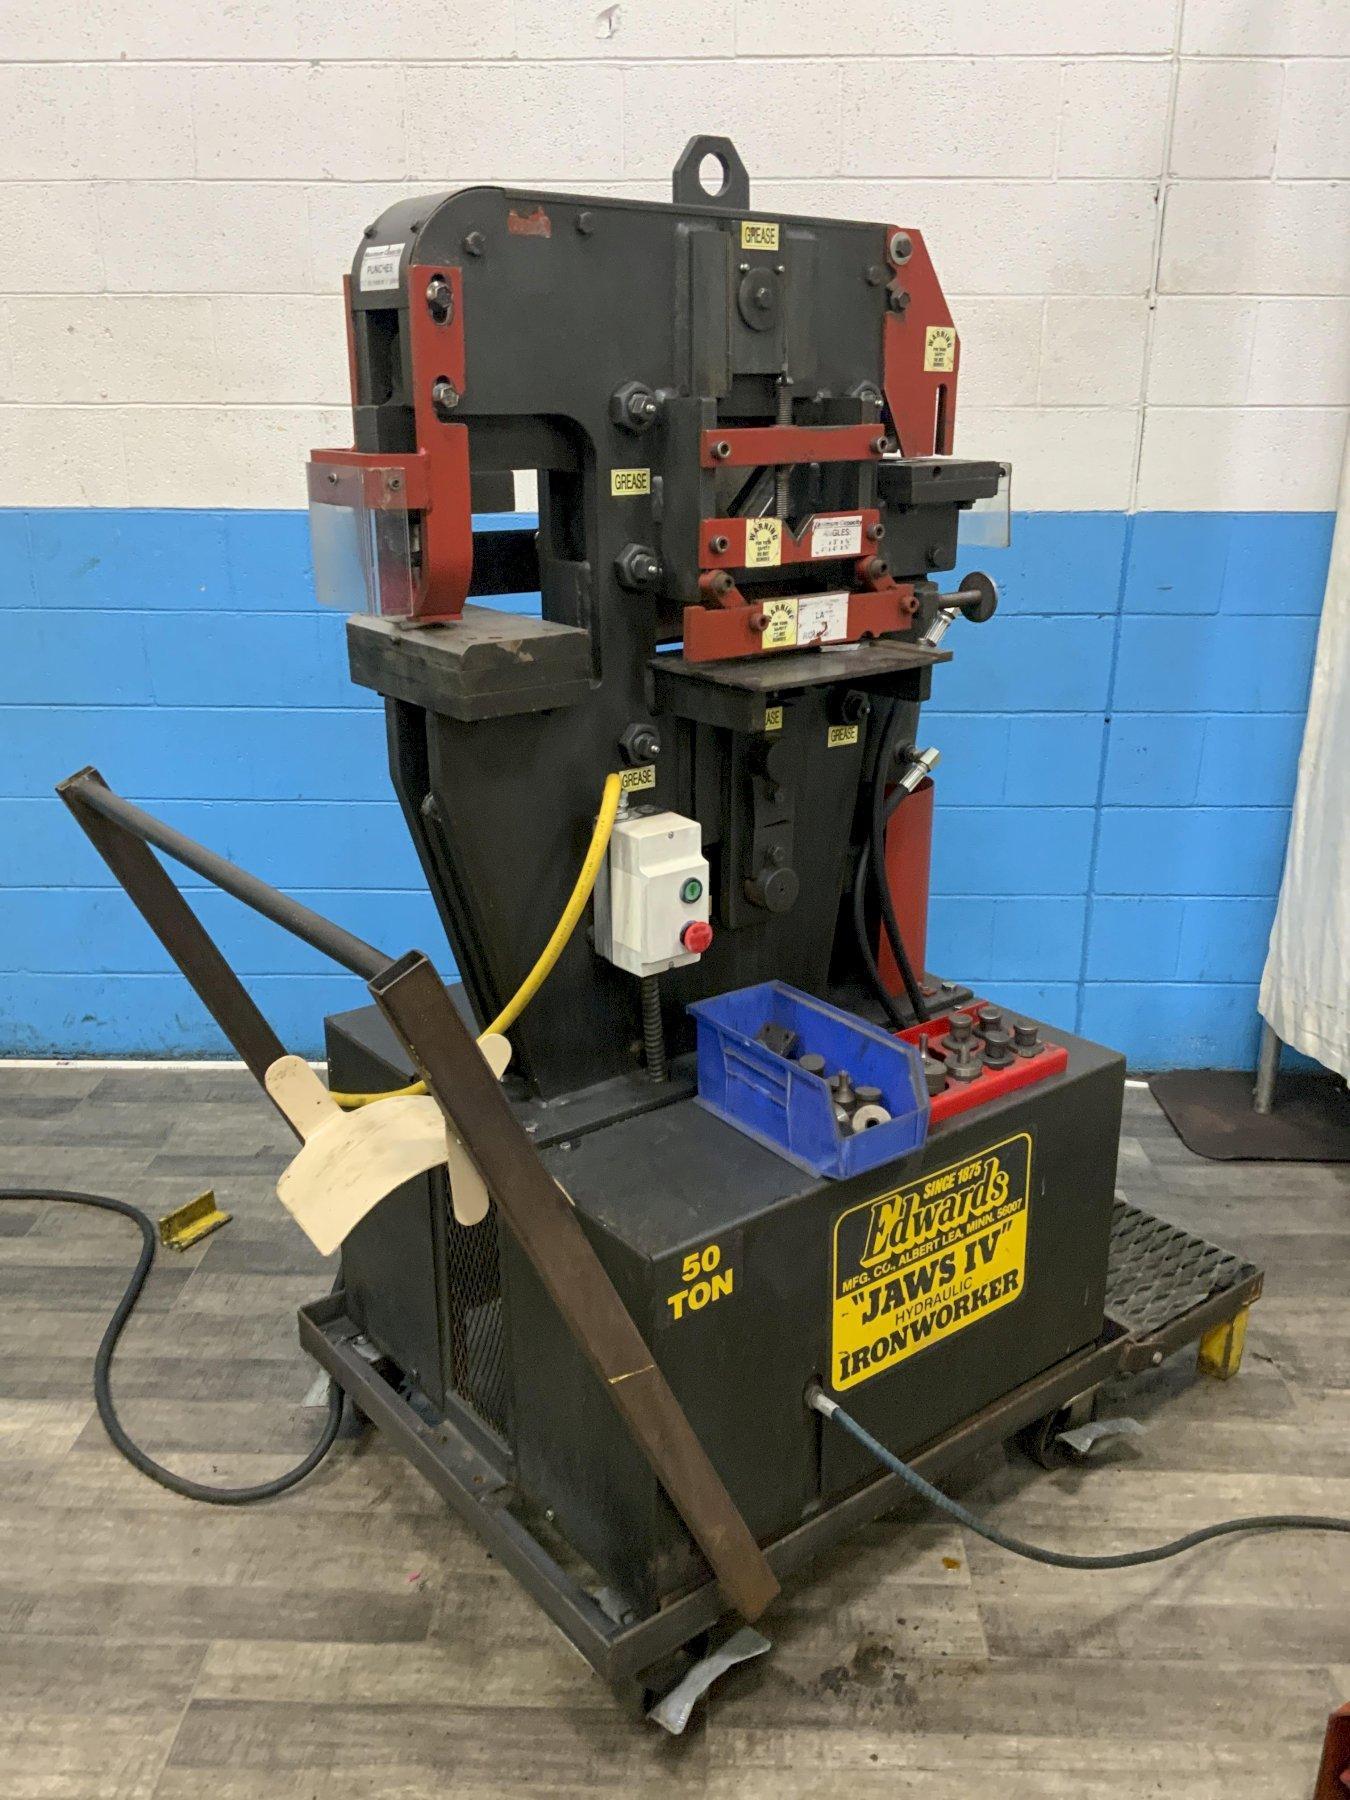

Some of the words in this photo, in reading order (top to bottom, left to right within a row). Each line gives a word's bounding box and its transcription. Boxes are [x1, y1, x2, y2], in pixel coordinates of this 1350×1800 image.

[745, 226, 775, 244] GREASE
[928, 330, 952, 349] WARNING
[615, 473, 647, 490] GREASE
[749, 522, 778, 541] WARNING
[830, 726, 856, 743] GREASE
[623, 769, 653, 788] GREASE
[923, 1171, 956, 1199] SINCE
[957, 1160, 983, 1184] 1875
[860, 1156, 1010, 1269] Edwards
[681, 1244, 721, 1282] 50
[842, 1271, 871, 1293] MFG.
[899, 1236, 940, 1267] ALBERT
[966, 1213, 995, 1233] MINN.
[851, 1251, 956, 1326] "JAWS
[963, 1219, 1013, 1275] IV"
[667, 1267, 734, 1320] TON
[895, 1276, 973, 1326] HYDRAULIC
[839, 1268, 1019, 1382] IRONWORKER
